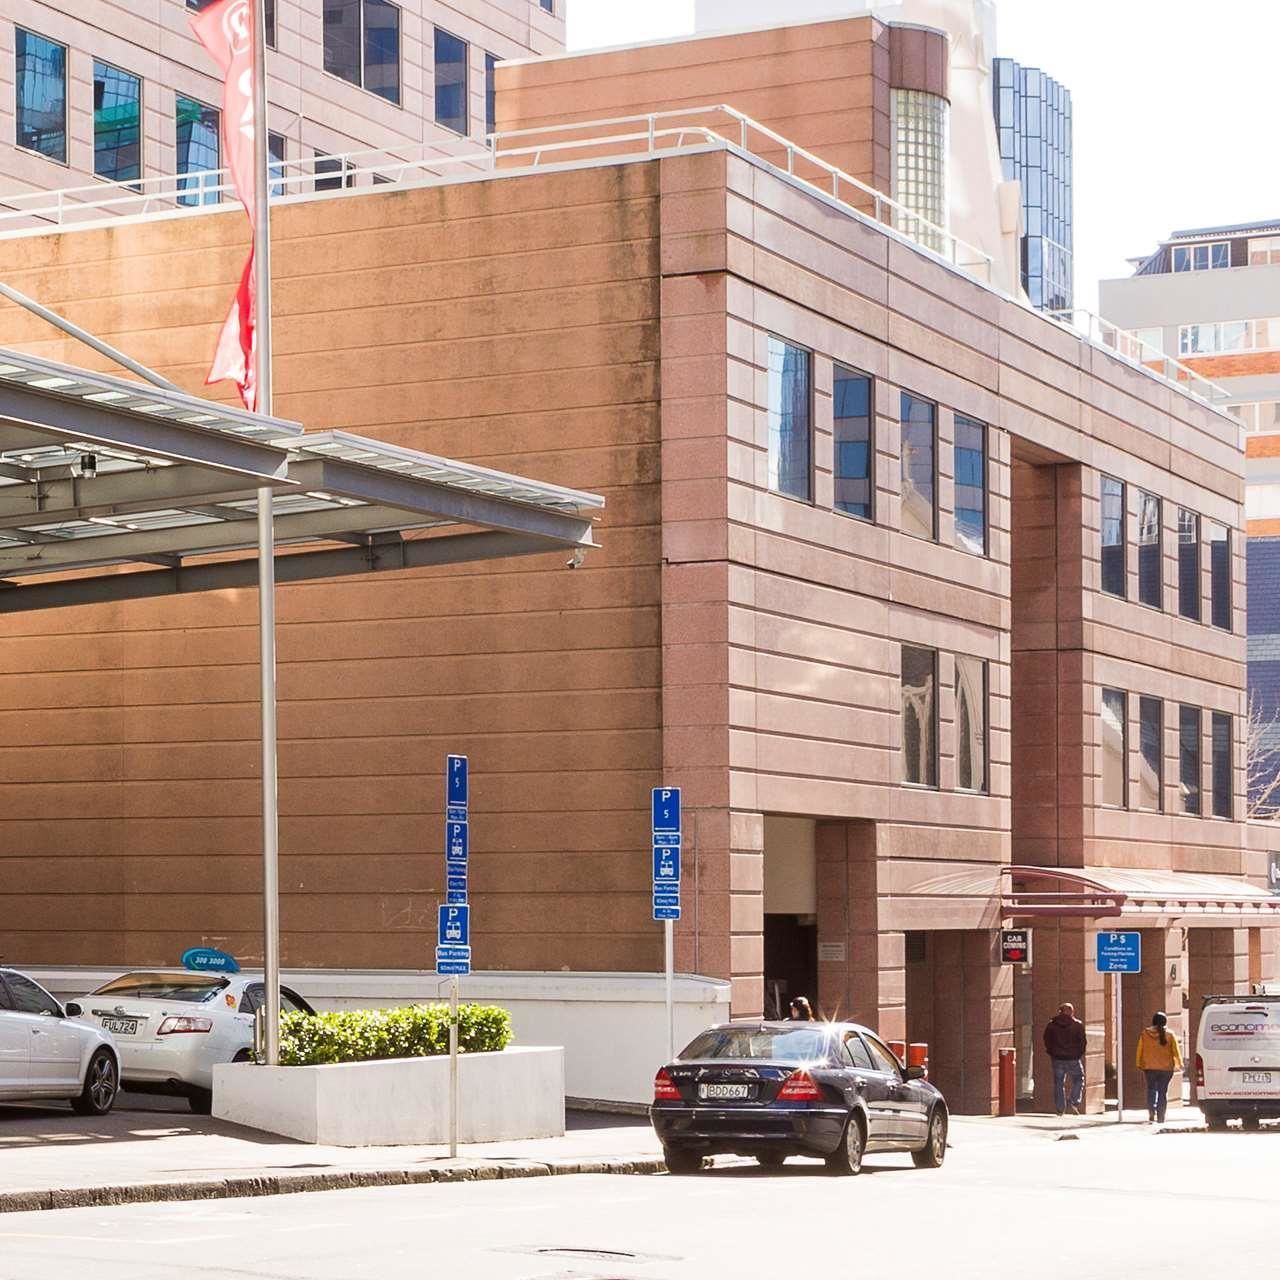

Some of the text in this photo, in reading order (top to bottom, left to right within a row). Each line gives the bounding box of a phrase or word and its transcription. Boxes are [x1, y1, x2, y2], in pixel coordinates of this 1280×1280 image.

[454, 759, 461, 771] P
[662, 791, 671, 802] P
[453, 824, 461, 837] P
[662, 849, 671, 860] P
[449, 908, 458, 920] P
[1110, 933, 1118, 943] P
